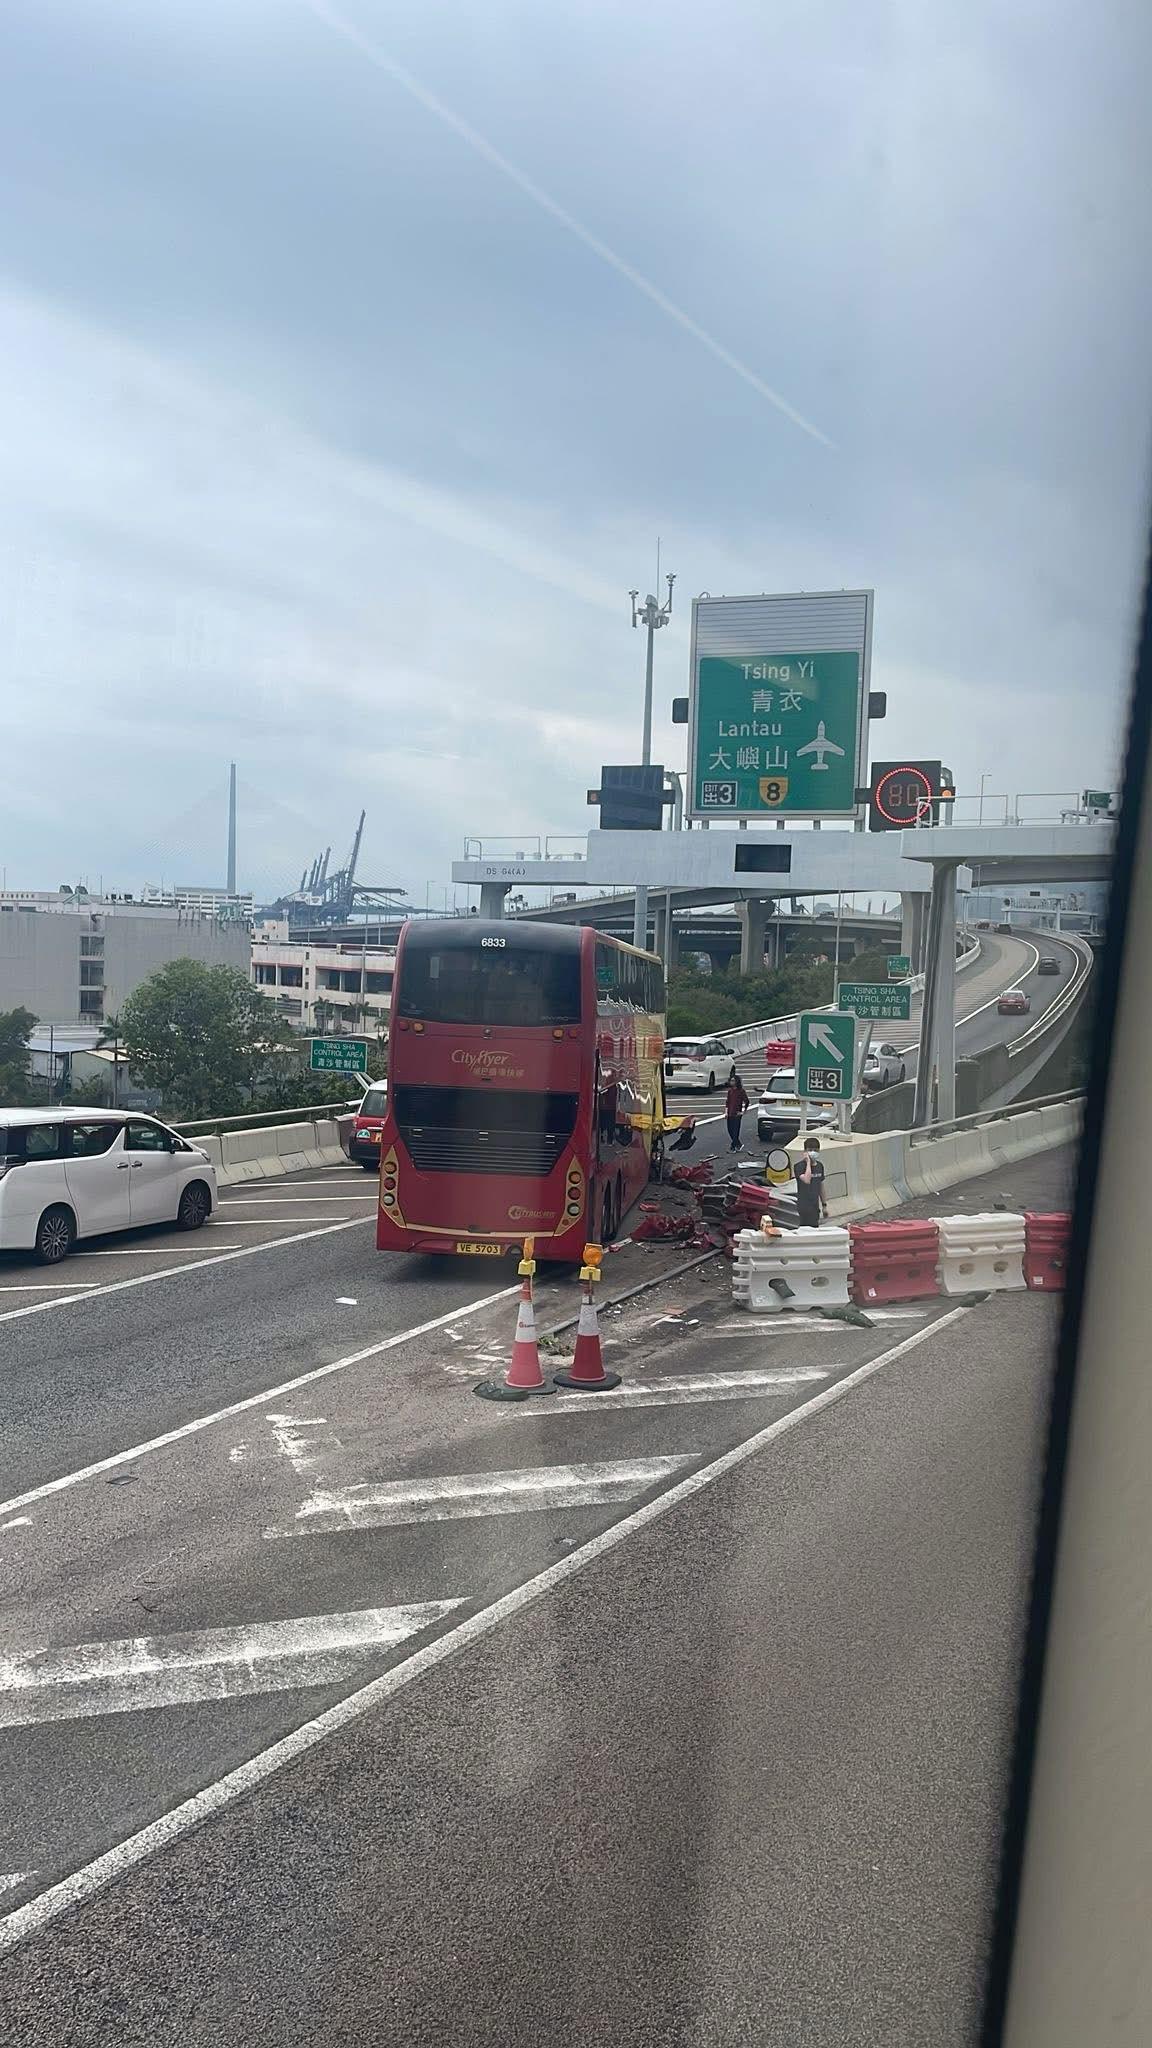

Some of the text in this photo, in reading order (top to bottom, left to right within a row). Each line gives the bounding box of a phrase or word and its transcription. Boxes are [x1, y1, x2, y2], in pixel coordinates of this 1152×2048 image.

[741, 660, 815, 682] Tsing Yi
[751, 688, 803, 713] 青衣
[718, 720, 783, 737] Lantau
[708, 745, 789, 770] 大嶼山
[719, 784, 732, 803] 3
[766, 782, 780, 801] 8
[889, 783, 919, 807] 80
[486, 867, 497, 875] DS
[481, 937, 506, 948] 6833
[841, 994, 907, 1003] CONTROL AREA
[854, 987, 897, 995] TSING SHA
[810, 1069, 824, 1079] EXIT
[825, 1072, 838, 1090] 3
[810, 1078, 823, 1089] 出
[460, 1244, 499, 1254] VE 5703
